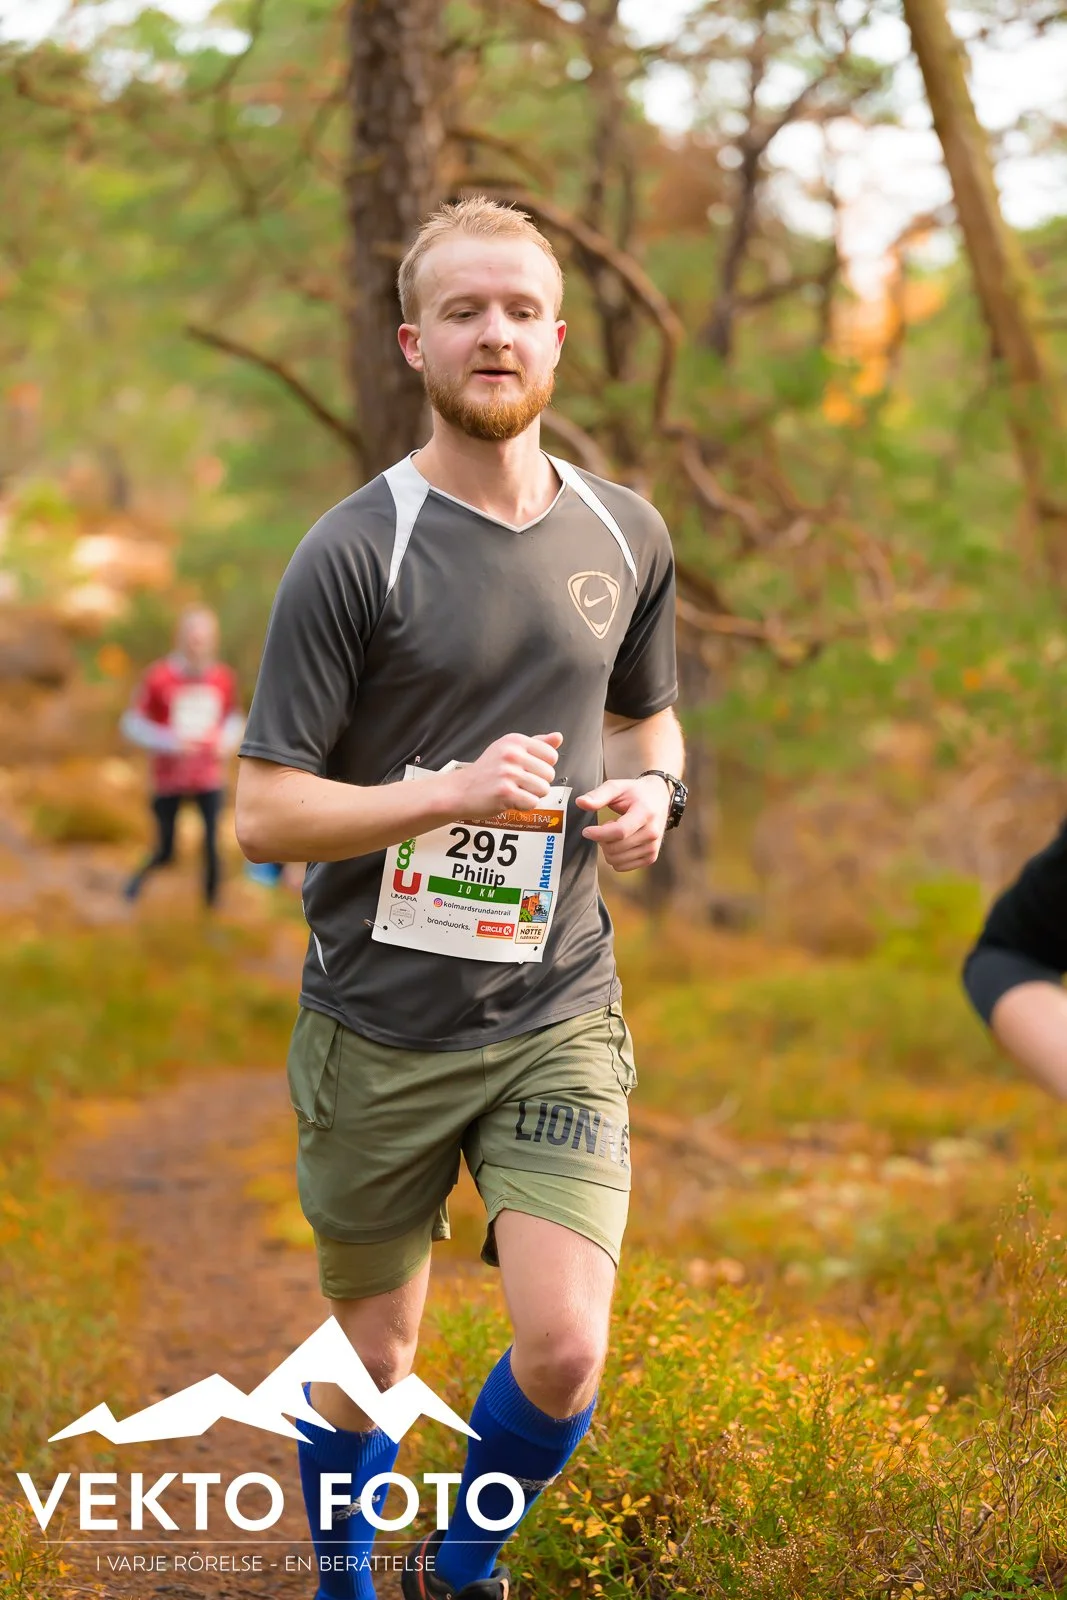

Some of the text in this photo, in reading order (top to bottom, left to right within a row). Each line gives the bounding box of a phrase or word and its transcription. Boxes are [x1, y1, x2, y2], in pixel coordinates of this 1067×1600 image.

[445, 826, 519, 867] 295
[539, 835, 556, 890] Aktivitus
[452, 863, 505, 889] Philip
[390, 893, 418, 903] UMARA
[458, 884, 496, 899] 10 KM
[480, 924, 503, 934] CIRCLE
